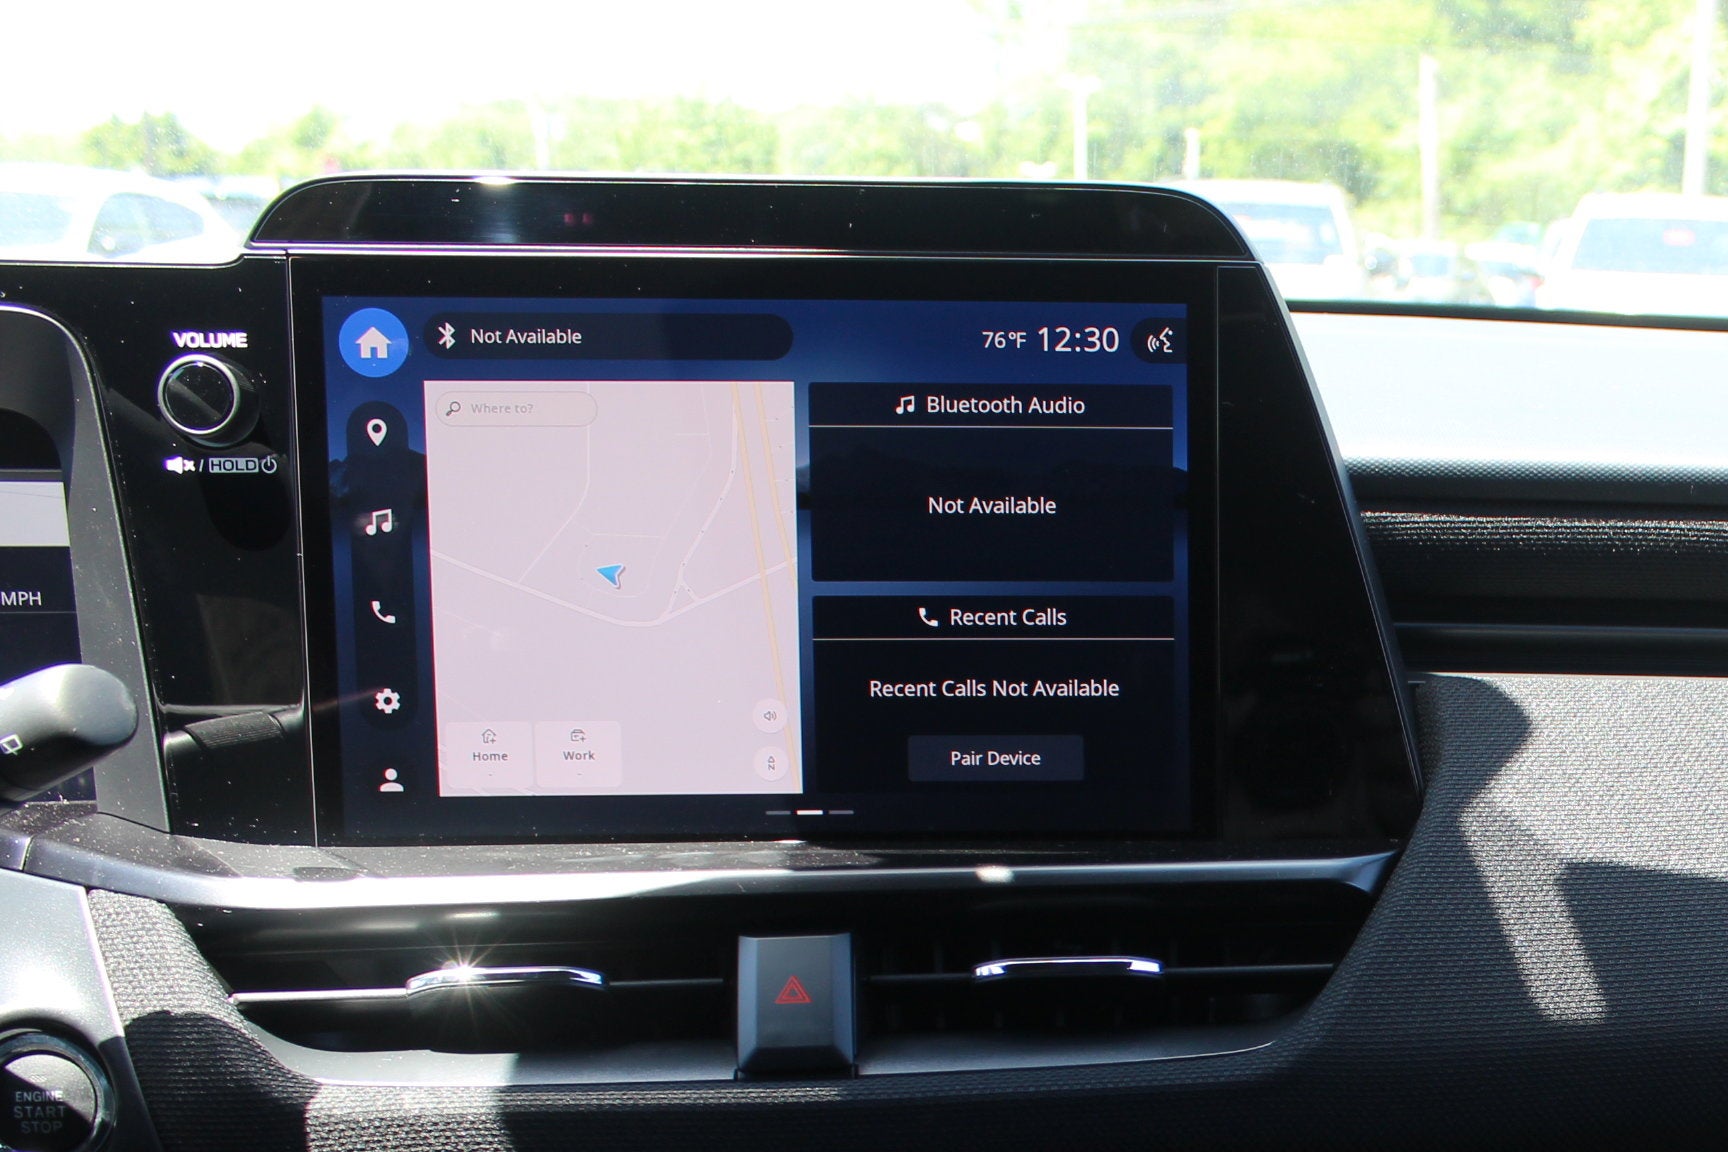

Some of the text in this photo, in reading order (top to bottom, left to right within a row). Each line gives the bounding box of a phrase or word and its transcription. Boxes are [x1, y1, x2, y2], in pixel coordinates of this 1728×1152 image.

[173, 332, 249, 349] VOLUME
[470, 328, 582, 344] Not Available
[981, 326, 1120, 353] 76°F 12:30
[470, 402, 534, 416] Where to?
[926, 395, 1086, 414] Bluetooth Audio
[210, 459, 258, 472] HOLD
[928, 495, 1057, 514] Not Available
[0, 590, 42, 606] MPH
[949, 607, 1067, 627] Recent Calls
[869, 678, 1120, 698] Recent Calls Not Available
[472, 750, 508, 762] Home
[562, 749, 595, 761] Work
[950, 748, 1041, 767] Pair Device
[15, 1091, 64, 1102] ENGINE
[14, 1105, 66, 1118] START
[21, 1120, 63, 1133] STOP
